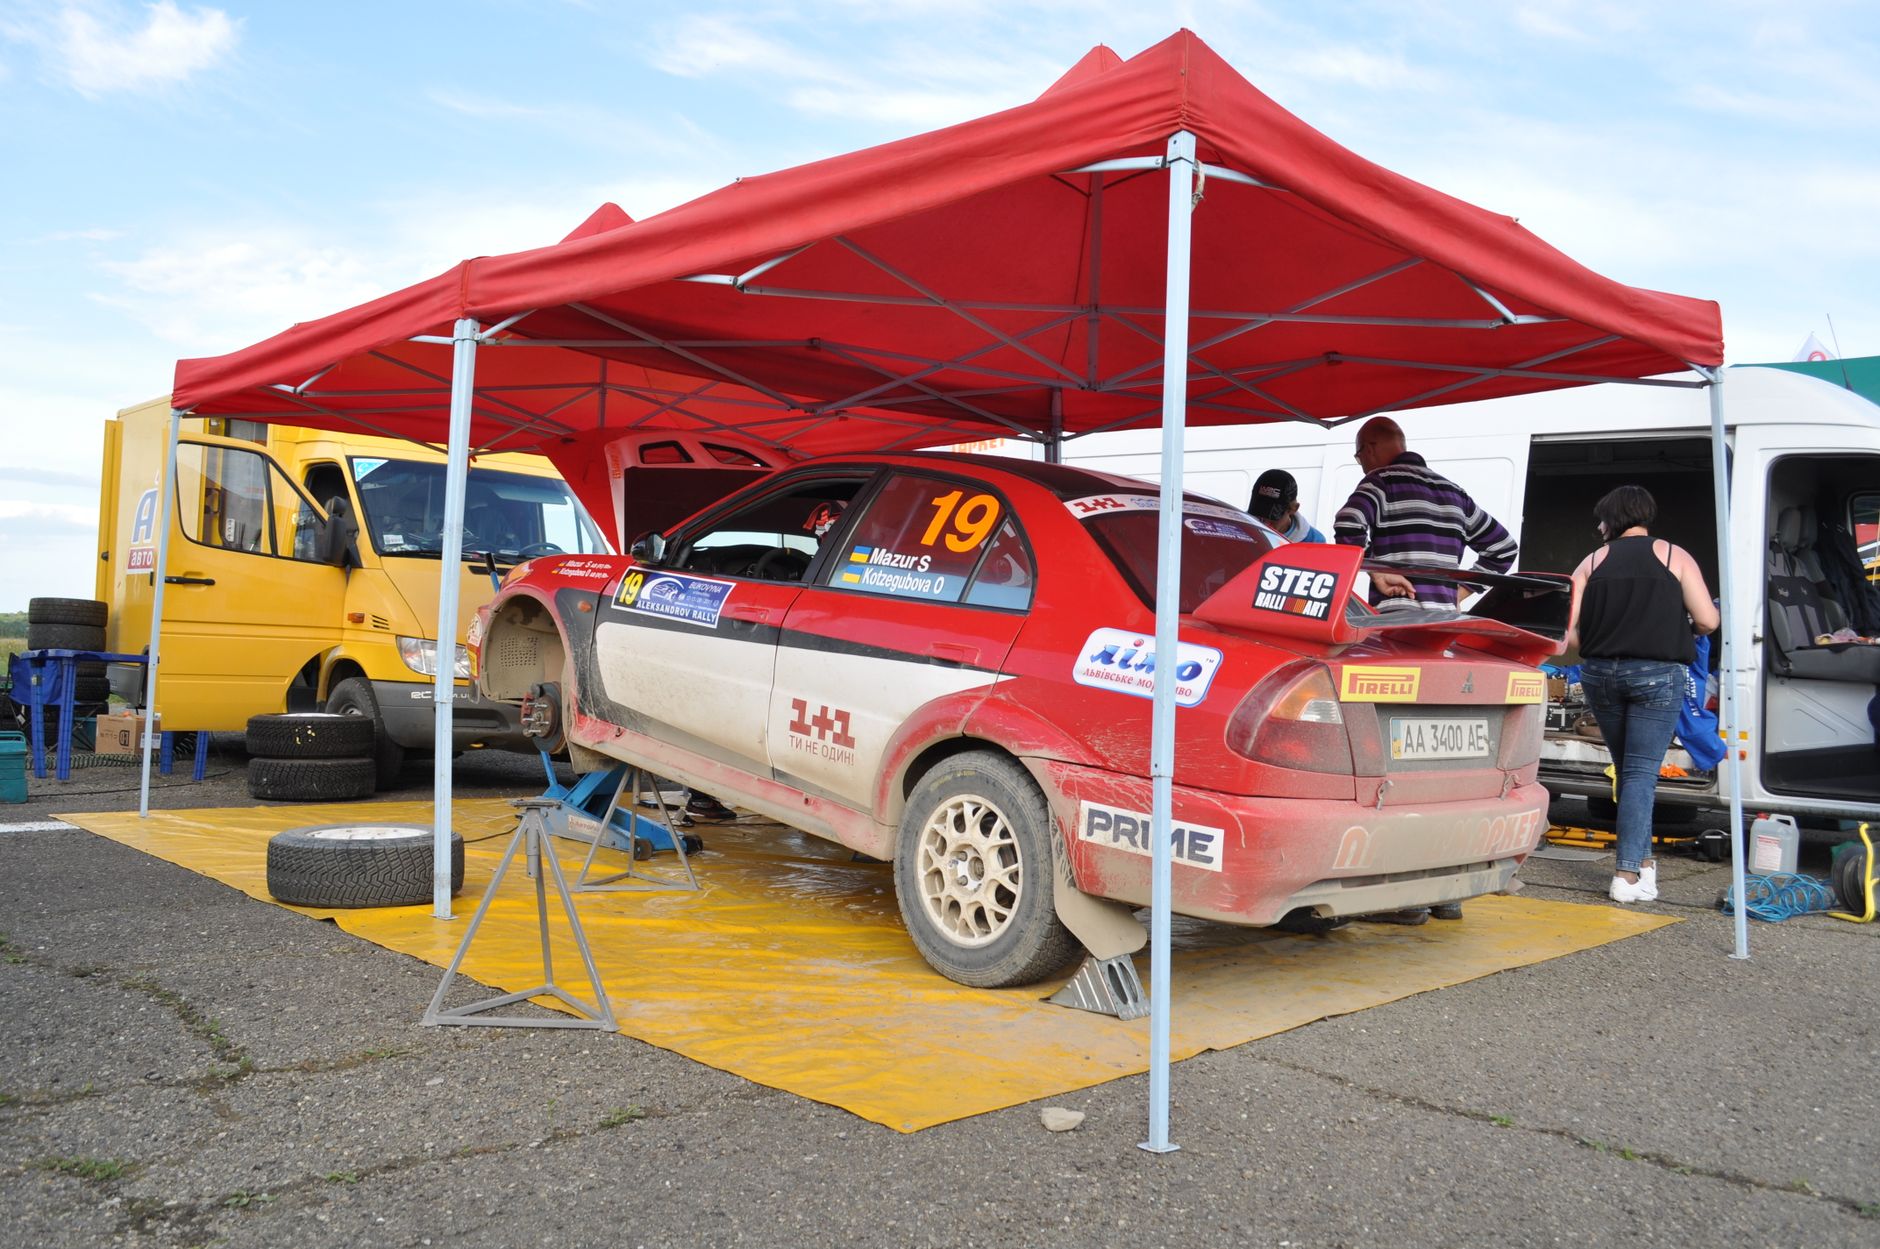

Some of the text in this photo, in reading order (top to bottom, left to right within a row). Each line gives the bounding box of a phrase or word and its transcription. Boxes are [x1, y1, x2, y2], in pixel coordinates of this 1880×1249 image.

[1074, 497, 1126, 513] 1+1
[920, 490, 1000, 553] 19
[869, 547, 932, 573] Mazur S
[619, 572, 643, 605] 19
[861, 567, 945, 595] Kotzegubova O
[1260, 566, 1335, 599] STEC
[636, 600, 690, 618] ALEKSANDROV
[692, 610, 717, 623] RALLY
[1254, 591, 1328, 618] RALLI ART
[1348, 672, 1415, 695] PIRELLI
[1510, 679, 1542, 697] PIRELLI
[789, 697, 856, 750] 1+1
[789, 734, 855, 766] ТИ НЕ ОДИН!
[1404, 724, 1484, 753] AA 3400 AE
